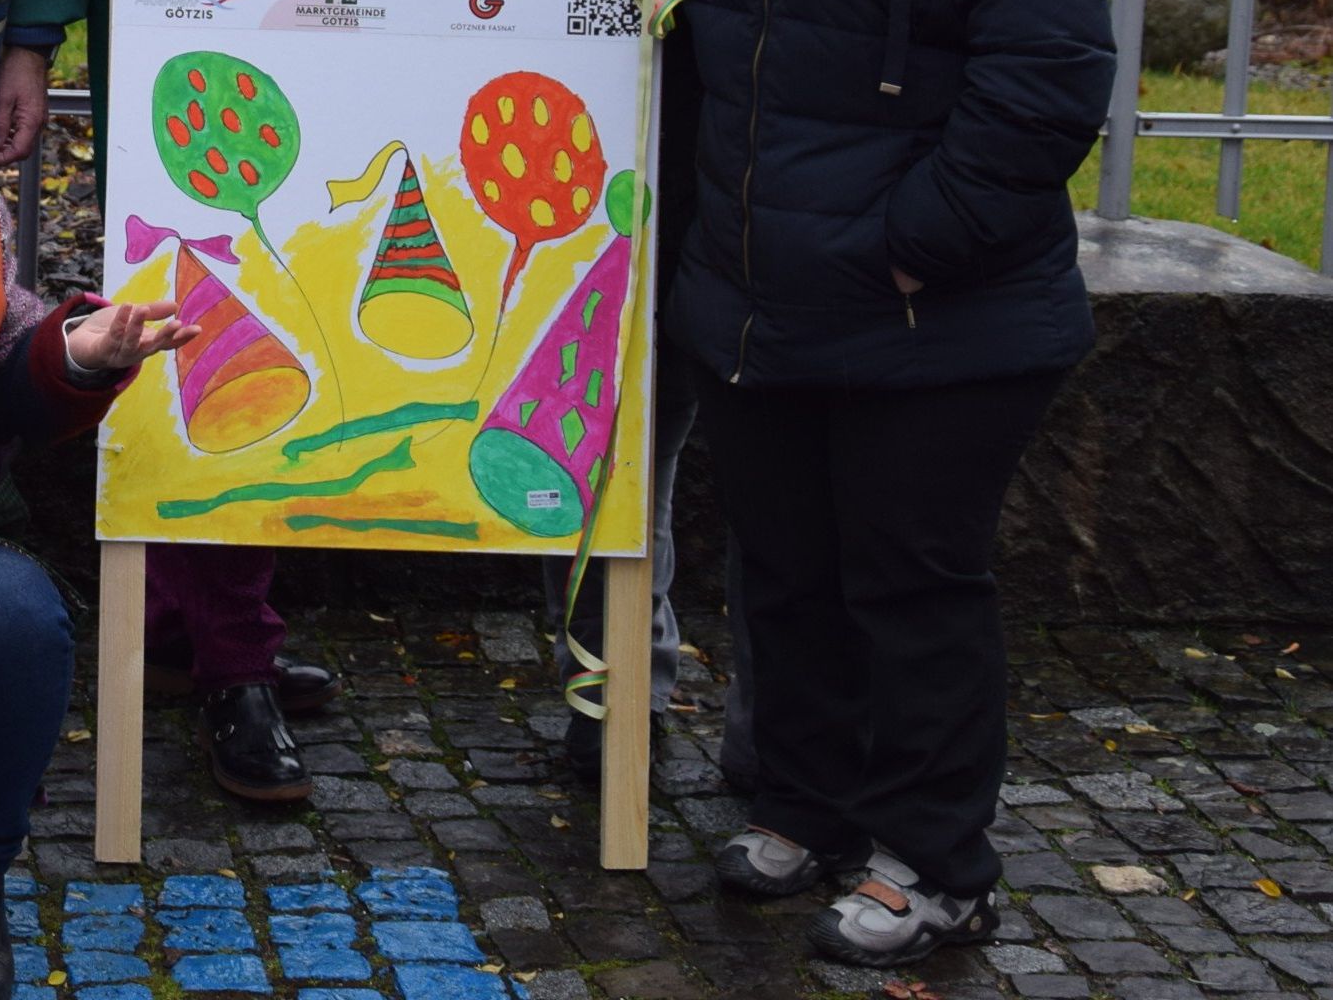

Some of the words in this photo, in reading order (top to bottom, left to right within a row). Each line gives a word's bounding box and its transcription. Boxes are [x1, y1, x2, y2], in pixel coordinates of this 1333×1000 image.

[165, 6, 214, 20] GÖTZIS
[295, 6, 386, 18] MARKTGEMEINDE
[450, 22, 486, 32] GÖTZNER
[488, 24, 516, 33] FASNAT
